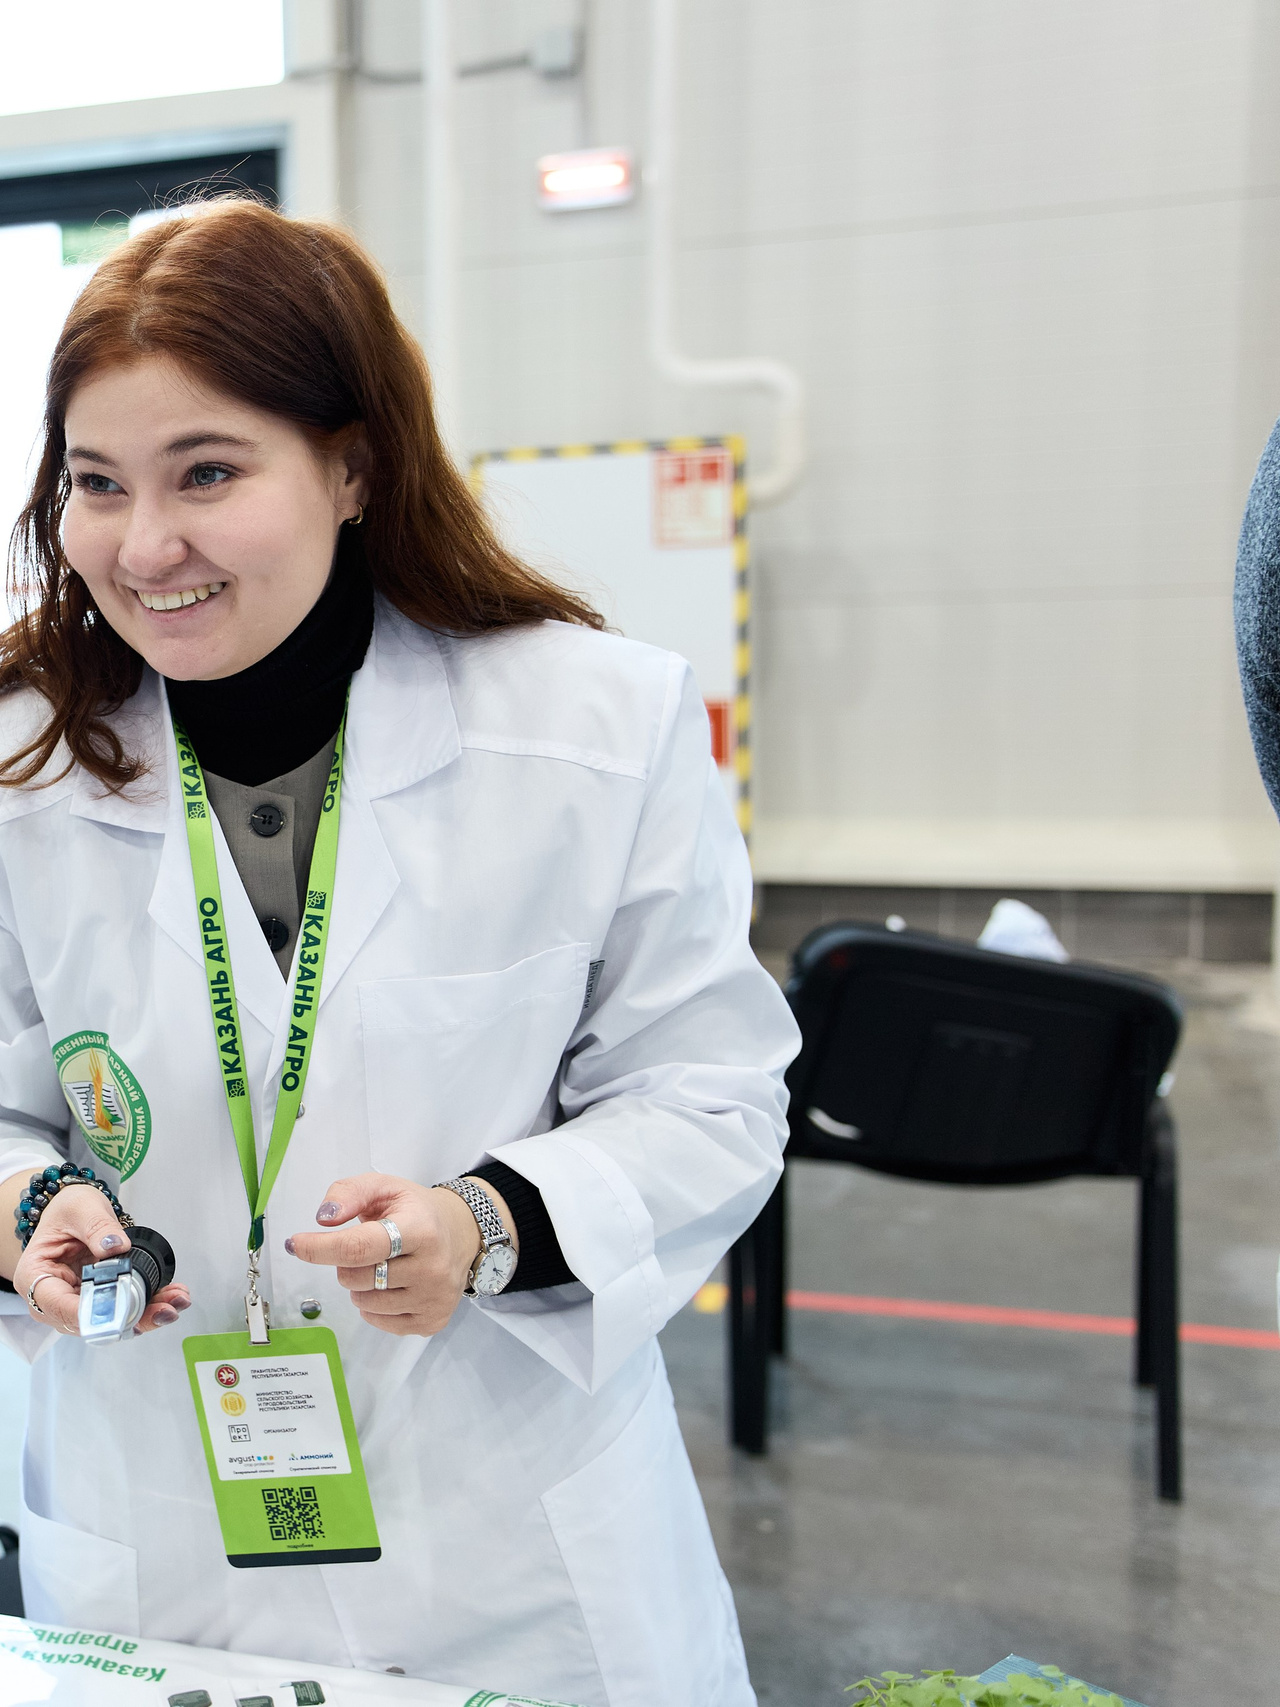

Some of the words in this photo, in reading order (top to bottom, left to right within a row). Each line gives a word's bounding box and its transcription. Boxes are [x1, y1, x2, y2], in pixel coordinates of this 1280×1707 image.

[176, 717, 203, 796] КАЗА
[199, 897, 226, 964] АГРО
[293, 913, 325, 1019] КАЗАНЬ
[53, 1034, 105, 1062] СТВЕННЫЙ
[210, 970, 243, 1075] КАЗАНЬ
[281, 1023, 309, 1092] АГРО
[228, 1455, 256, 1465] avgust
[300, 1453, 334, 1461] АММОНИЙ
[29, 1626, 139, 1655] аграрны
